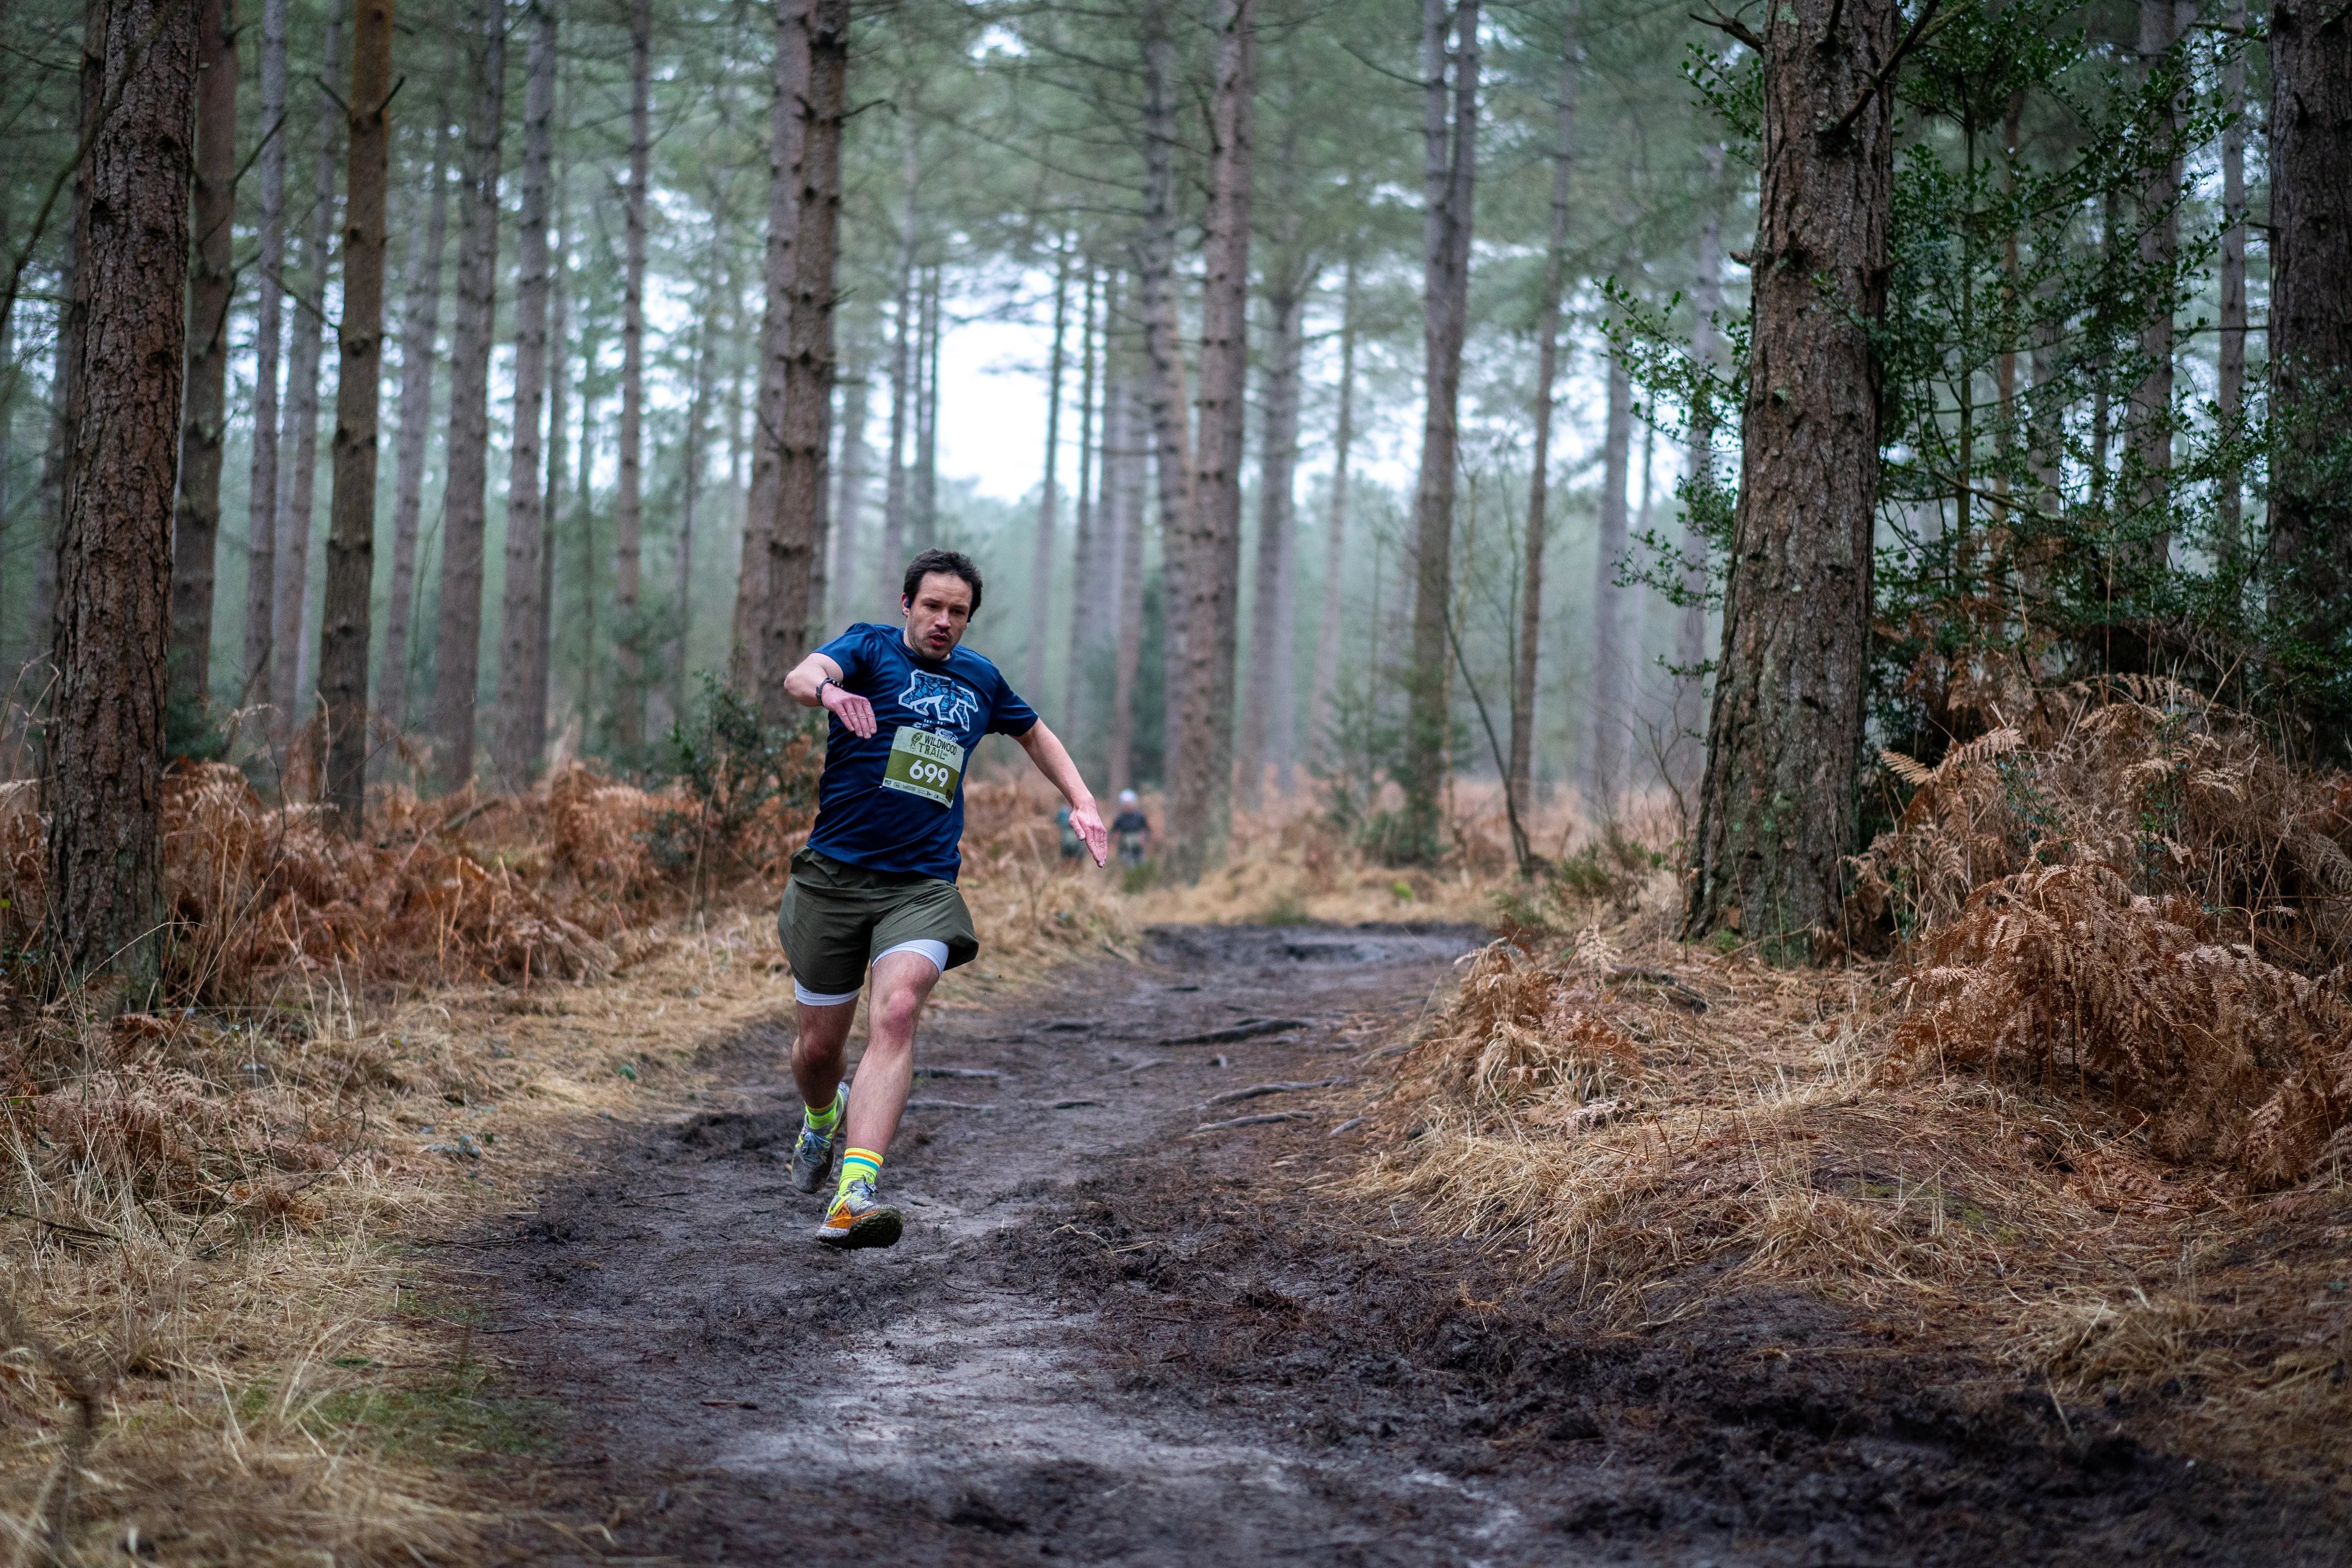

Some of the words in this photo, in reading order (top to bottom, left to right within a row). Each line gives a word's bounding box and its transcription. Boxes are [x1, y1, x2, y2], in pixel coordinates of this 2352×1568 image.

[919, 742, 945, 760] TRAIL
[925, 735, 957, 755] WILDWOOD
[909, 760, 948, 787] 699
